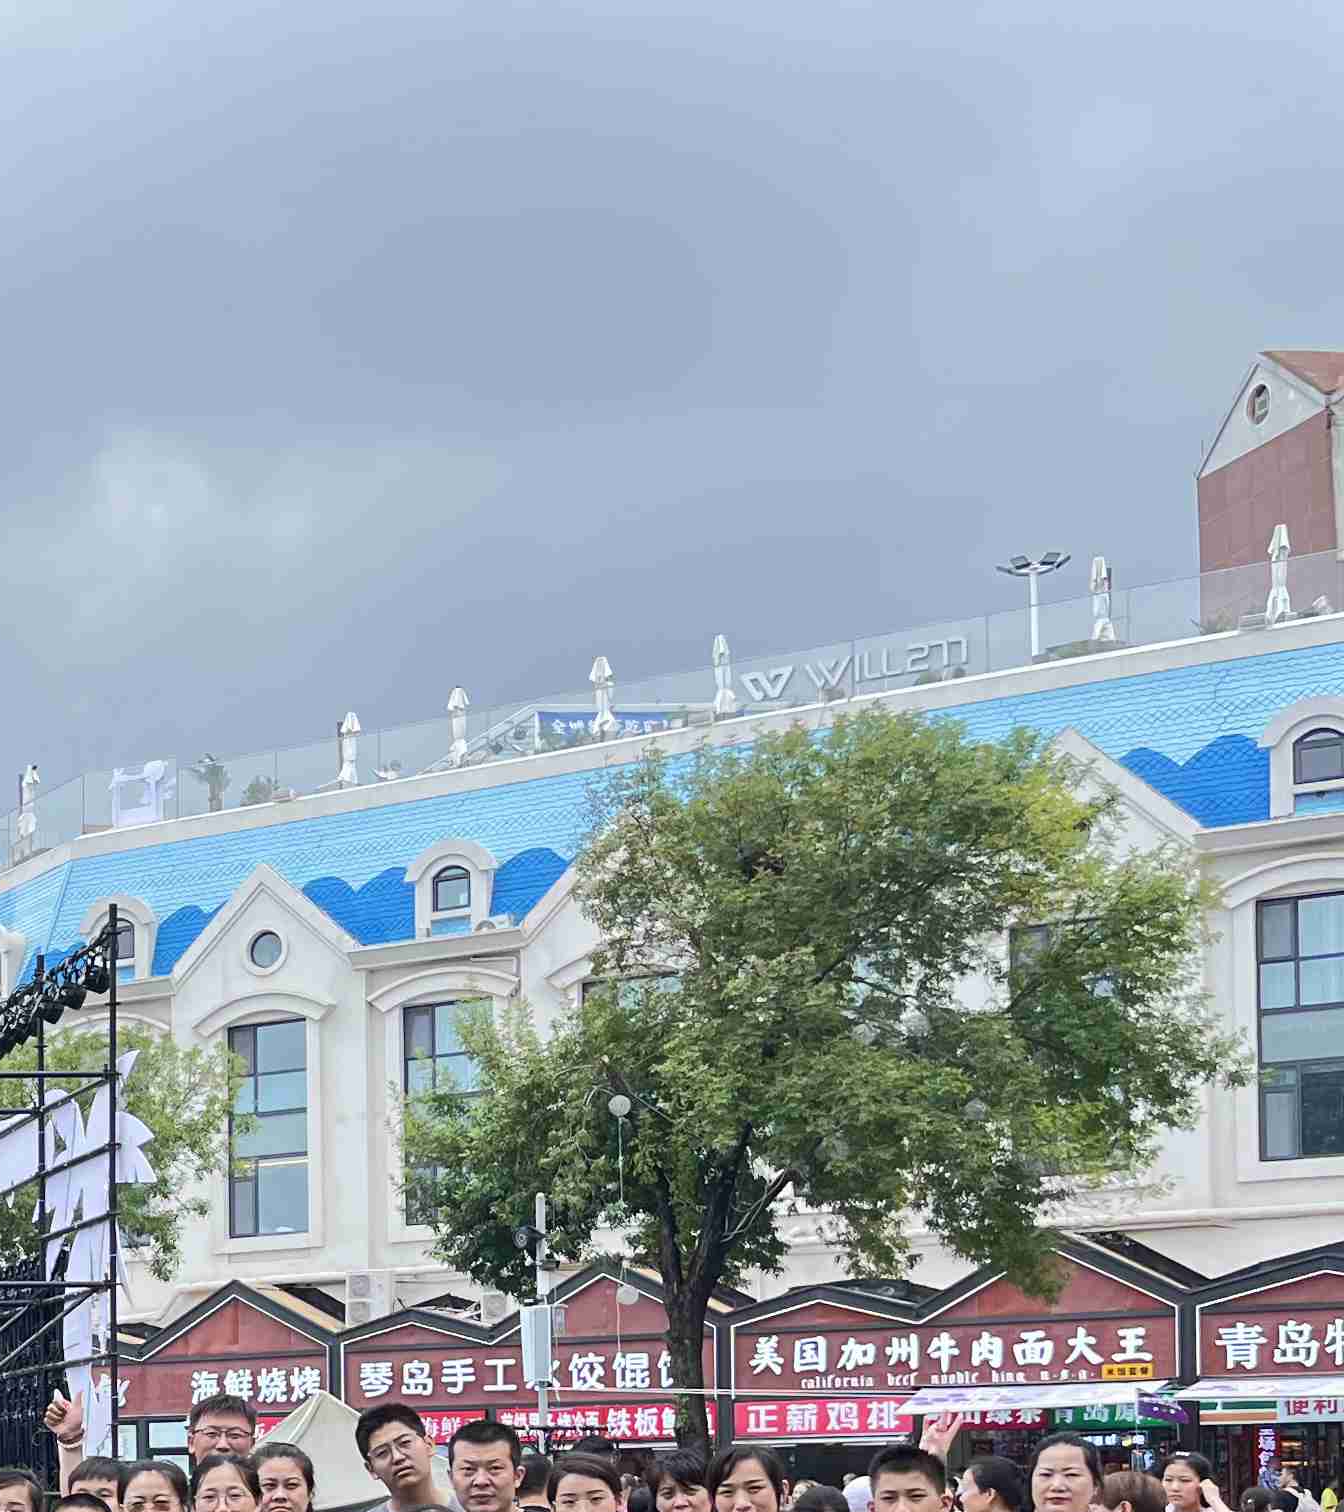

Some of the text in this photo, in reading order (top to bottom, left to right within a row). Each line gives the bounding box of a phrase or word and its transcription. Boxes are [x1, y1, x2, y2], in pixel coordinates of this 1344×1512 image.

[749, 1327, 1153, 1375] 美国加州牛肉面大王
[190, 1367, 321, 1402] 海鲜烧烤
[747, 1402, 899, 1433] 正新鸡排
